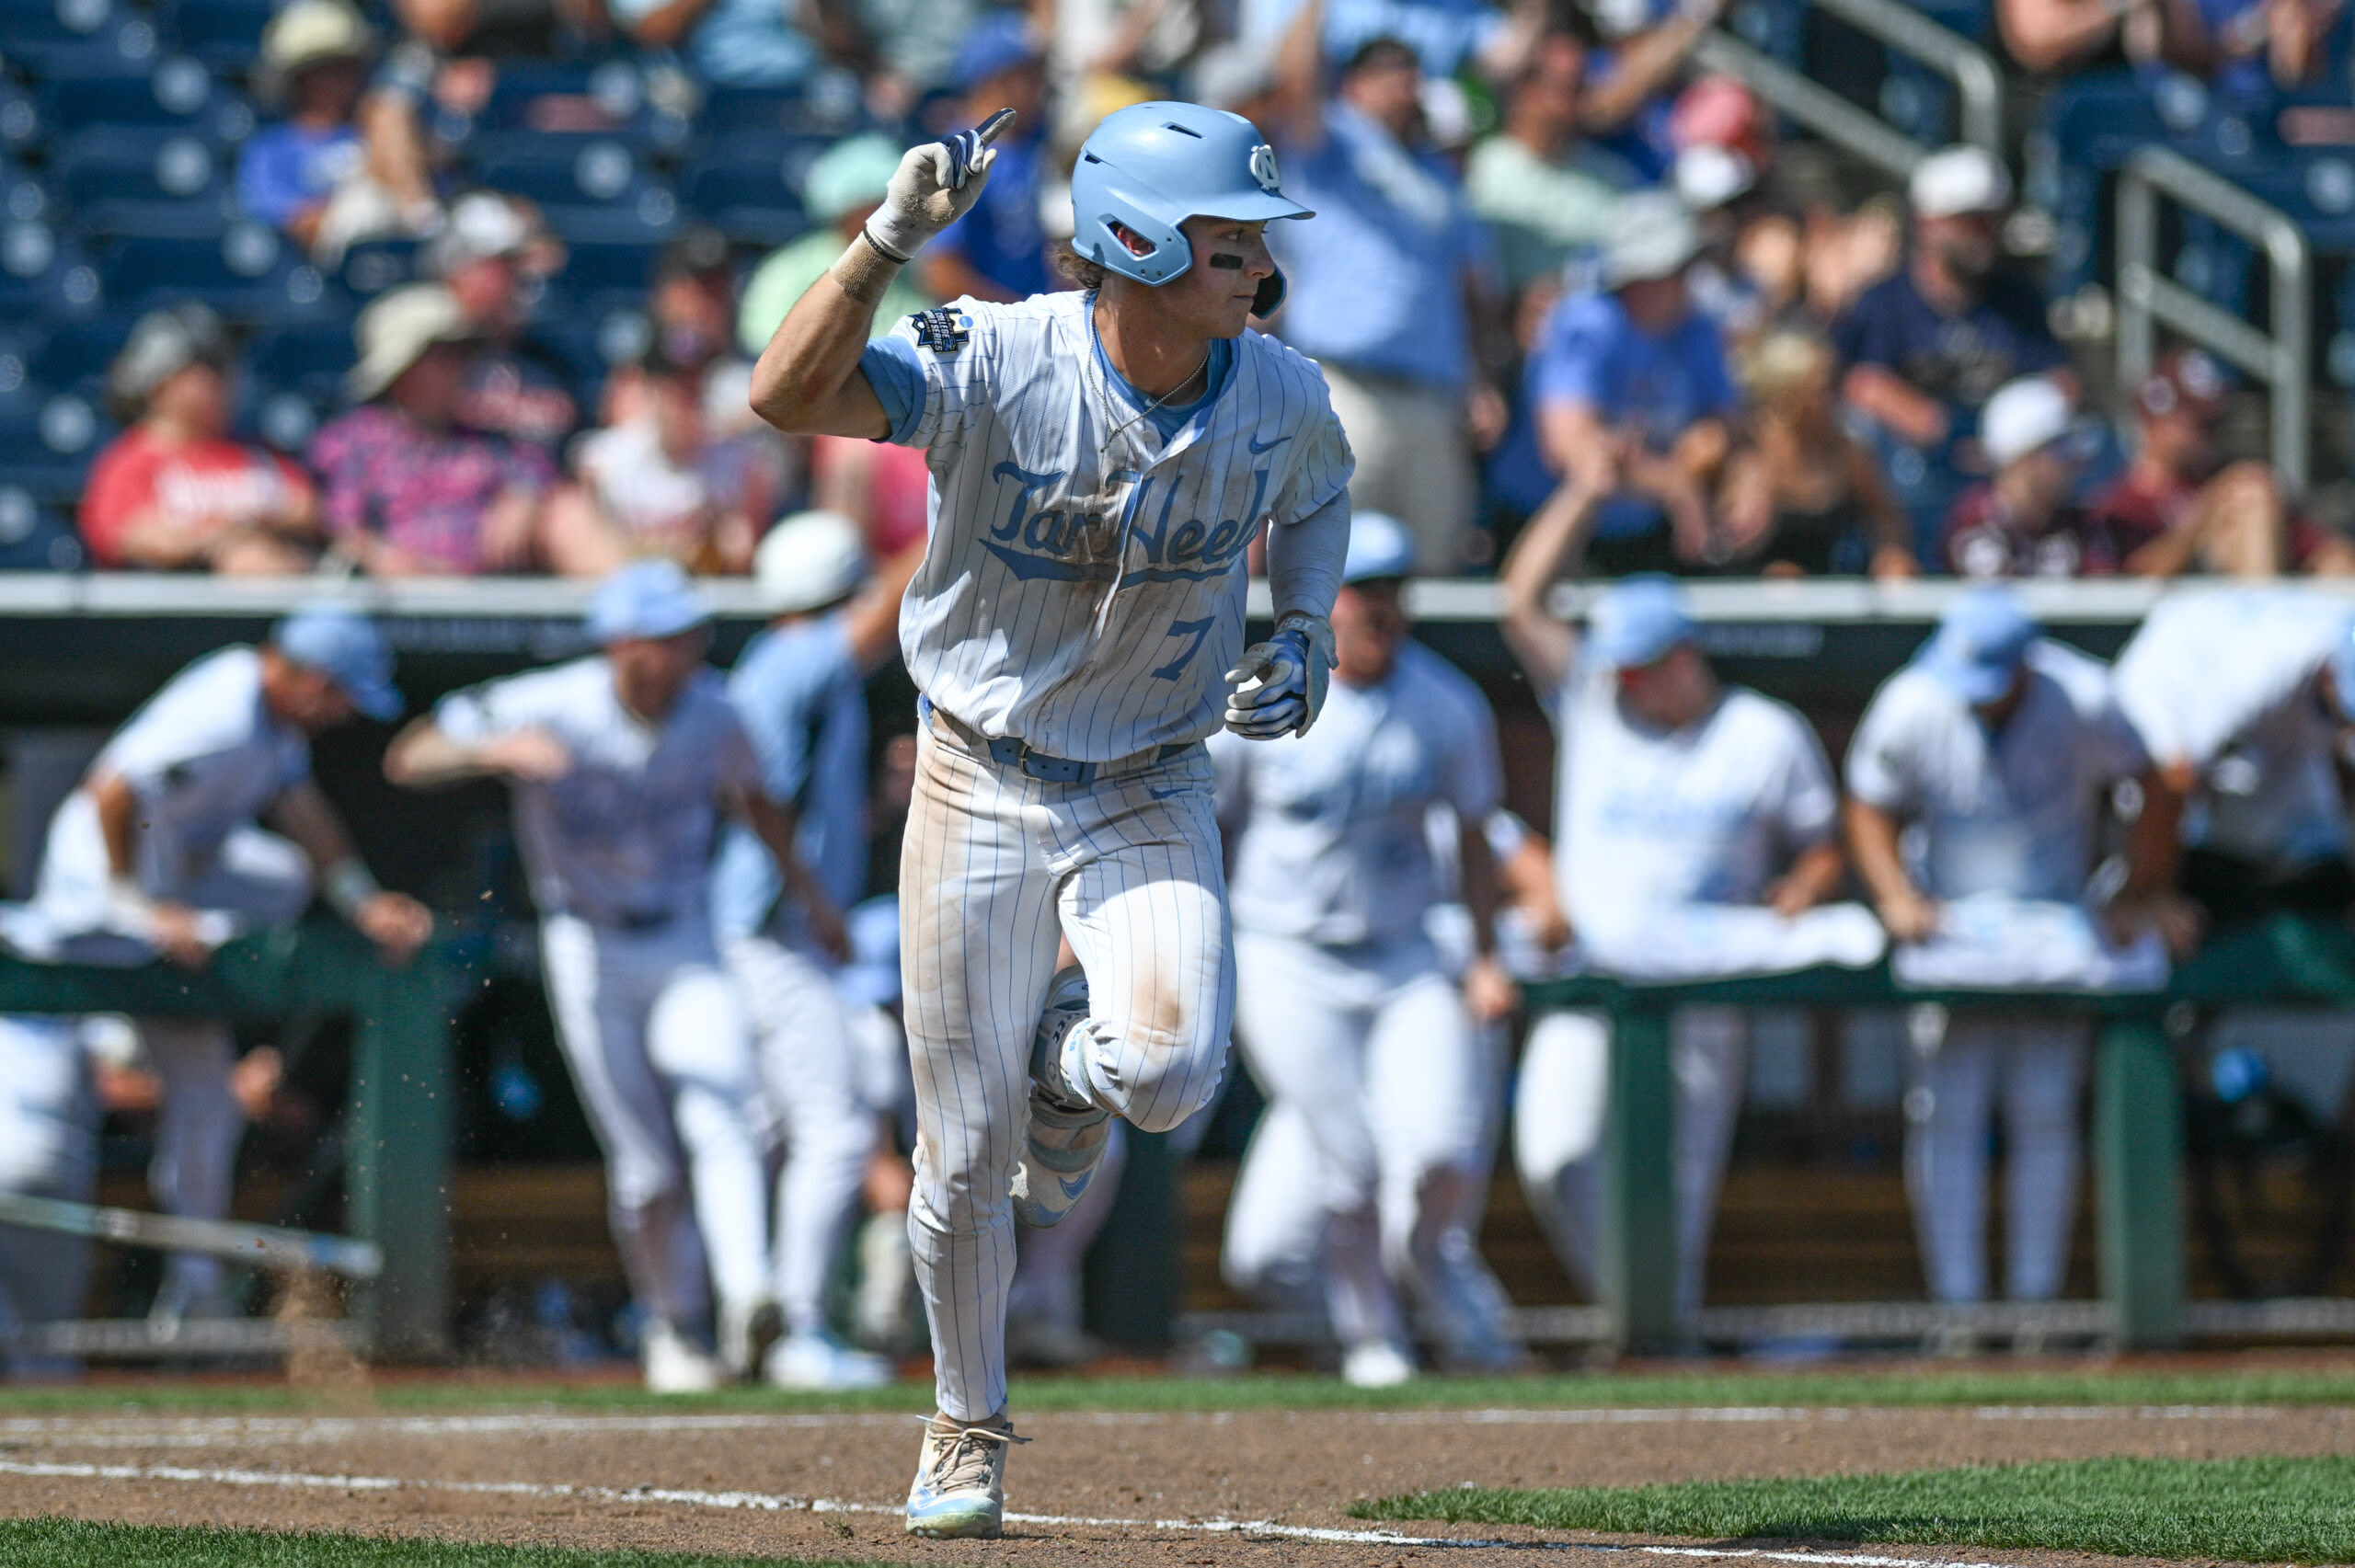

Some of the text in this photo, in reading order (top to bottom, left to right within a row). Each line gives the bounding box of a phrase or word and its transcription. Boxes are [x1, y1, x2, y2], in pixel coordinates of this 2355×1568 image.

[931, 325, 943, 351] SERIES
[934, 312, 950, 339] COLLEGE
[991, 462, 1269, 565] Tar Heel
[1151, 615, 1216, 681] 7
